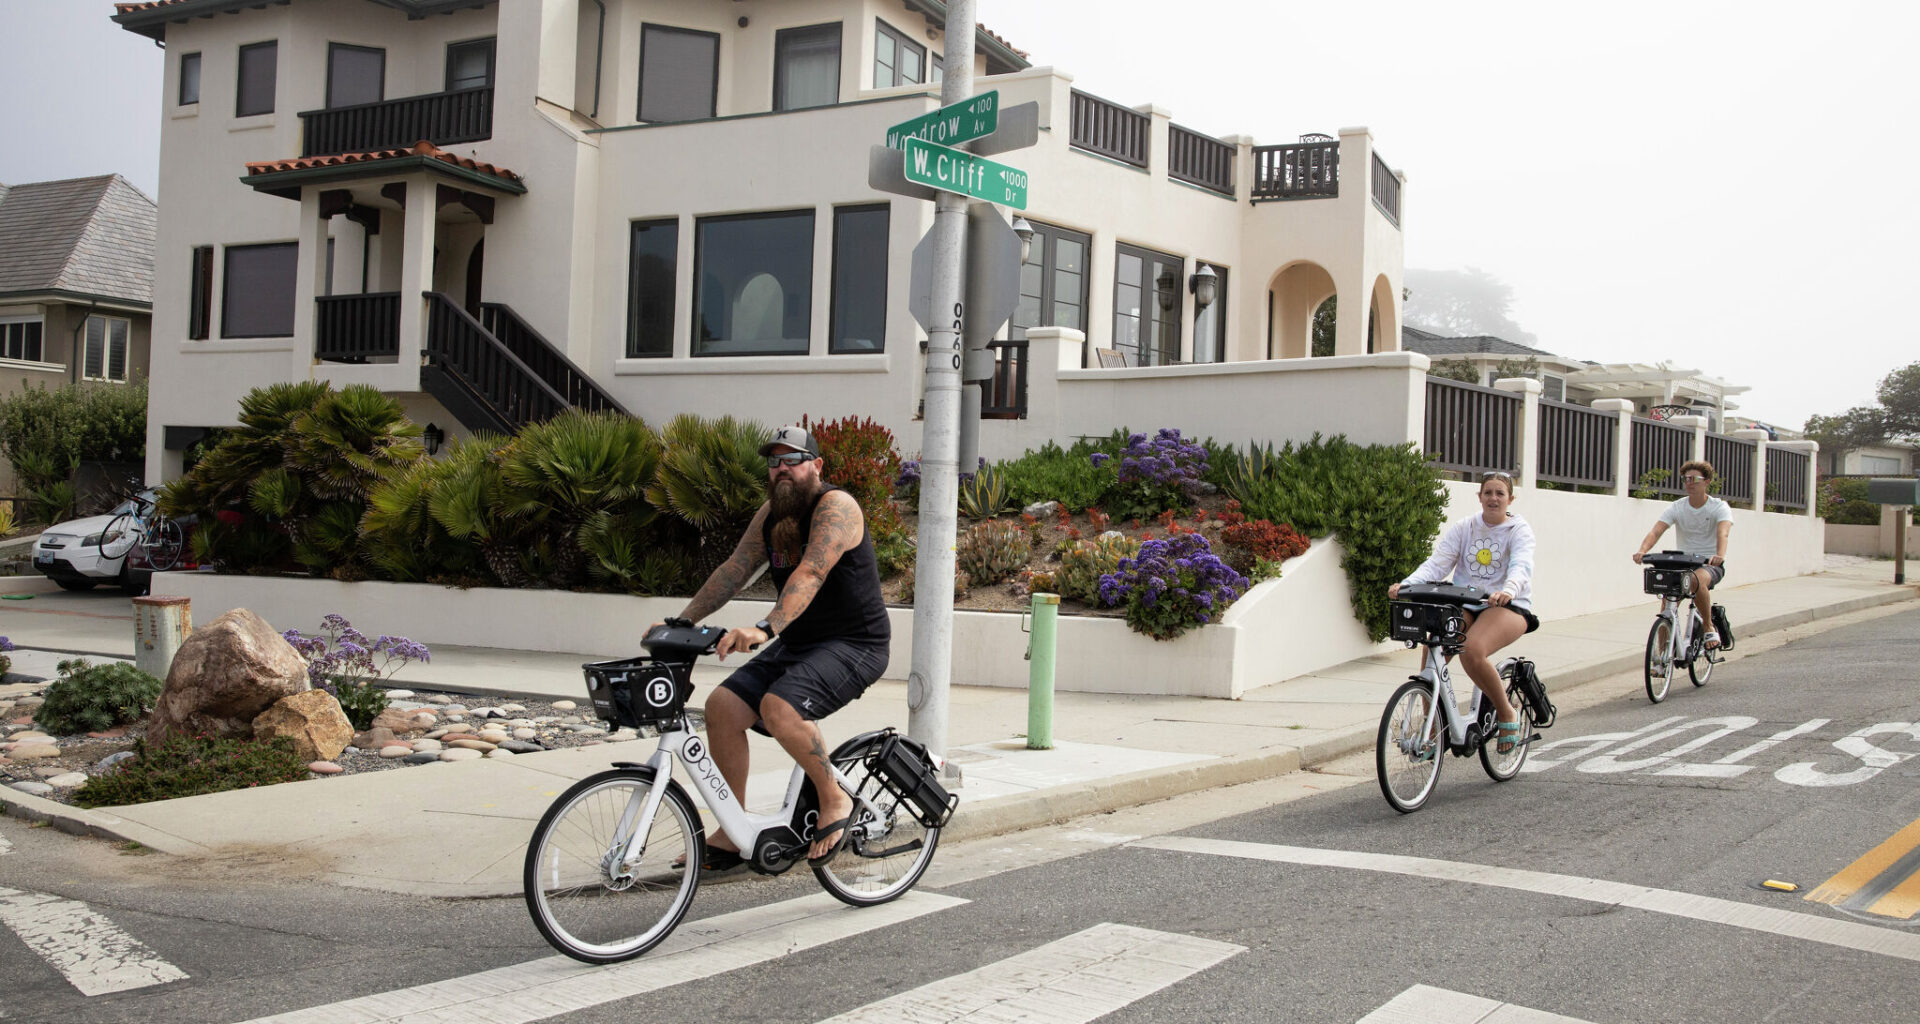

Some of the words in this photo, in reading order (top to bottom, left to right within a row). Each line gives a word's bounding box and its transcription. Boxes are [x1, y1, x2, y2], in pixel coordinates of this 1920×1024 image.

[977, 96, 992, 115] 100
[888, 115, 960, 151] Wodrow
[973, 119, 985, 135] Av
[937, 154, 985, 191] Cliff
[1005, 173, 1027, 189] 1000
[1005, 187, 1017, 203] Dr
[653, 682, 667, 701] B
[1499, 715, 1920, 787] STOP
